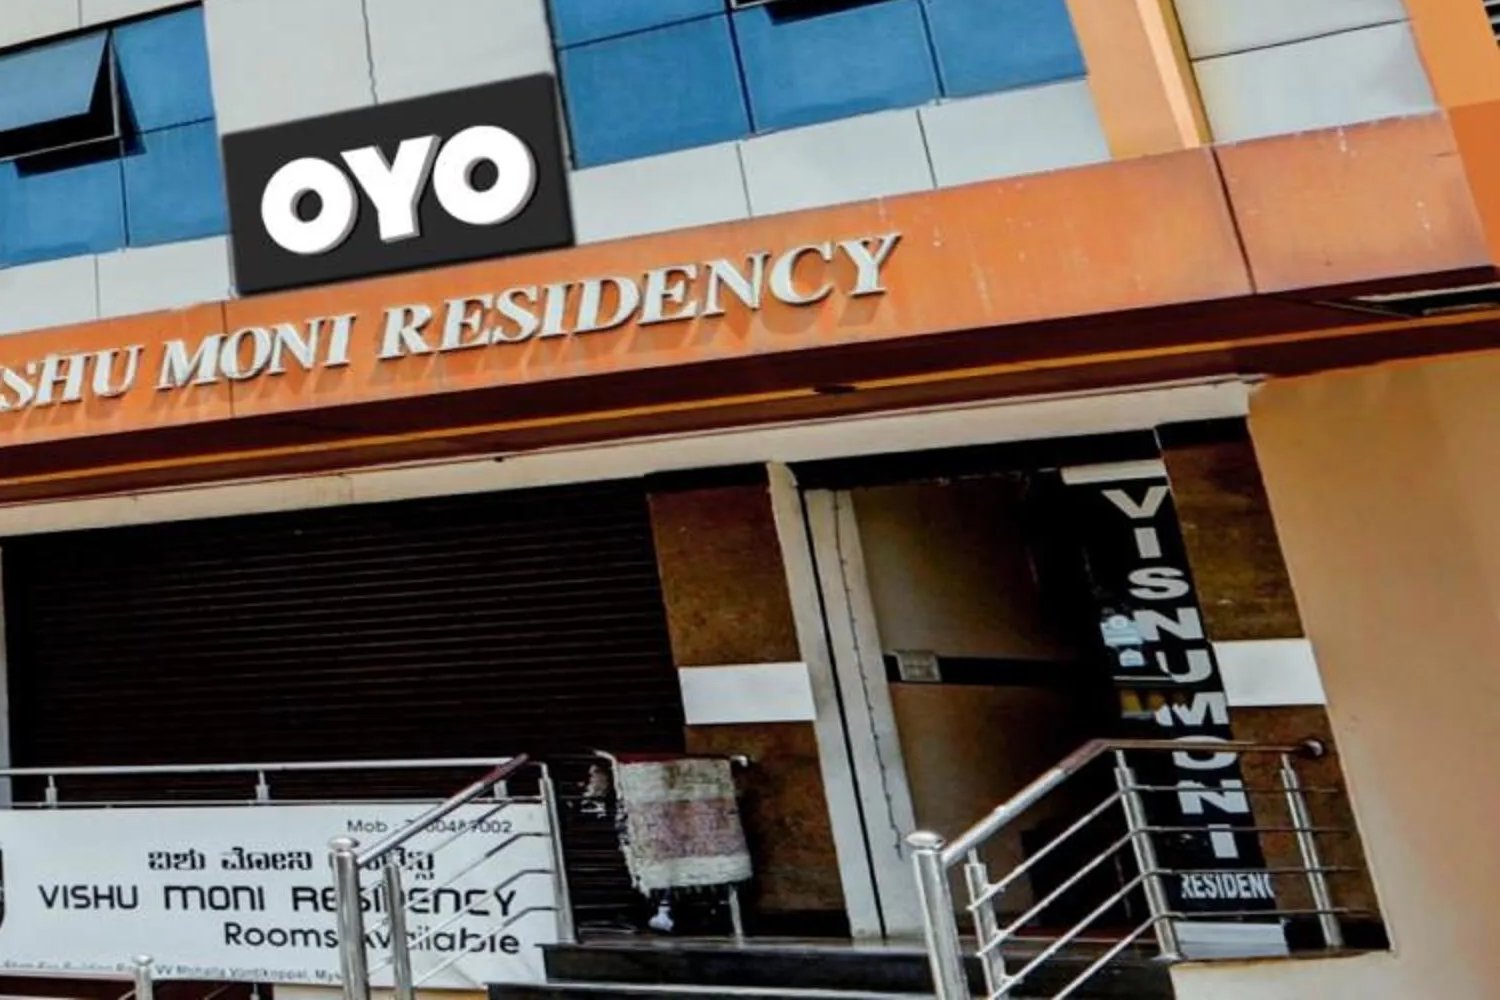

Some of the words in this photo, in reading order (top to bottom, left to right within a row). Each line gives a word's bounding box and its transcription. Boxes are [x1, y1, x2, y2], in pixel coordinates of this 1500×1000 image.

[261, 125, 536, 254] OYO
[156, 312, 356, 391] MONI
[378, 232, 900, 360] RESIDENCY
[347, 819, 388, 833] Mob
[38, 885, 138, 911] VISHU
[164, 885, 265, 911] MONI
[292, 885, 516, 916] RESIENCY
[224, 922, 339, 948] Rooms
